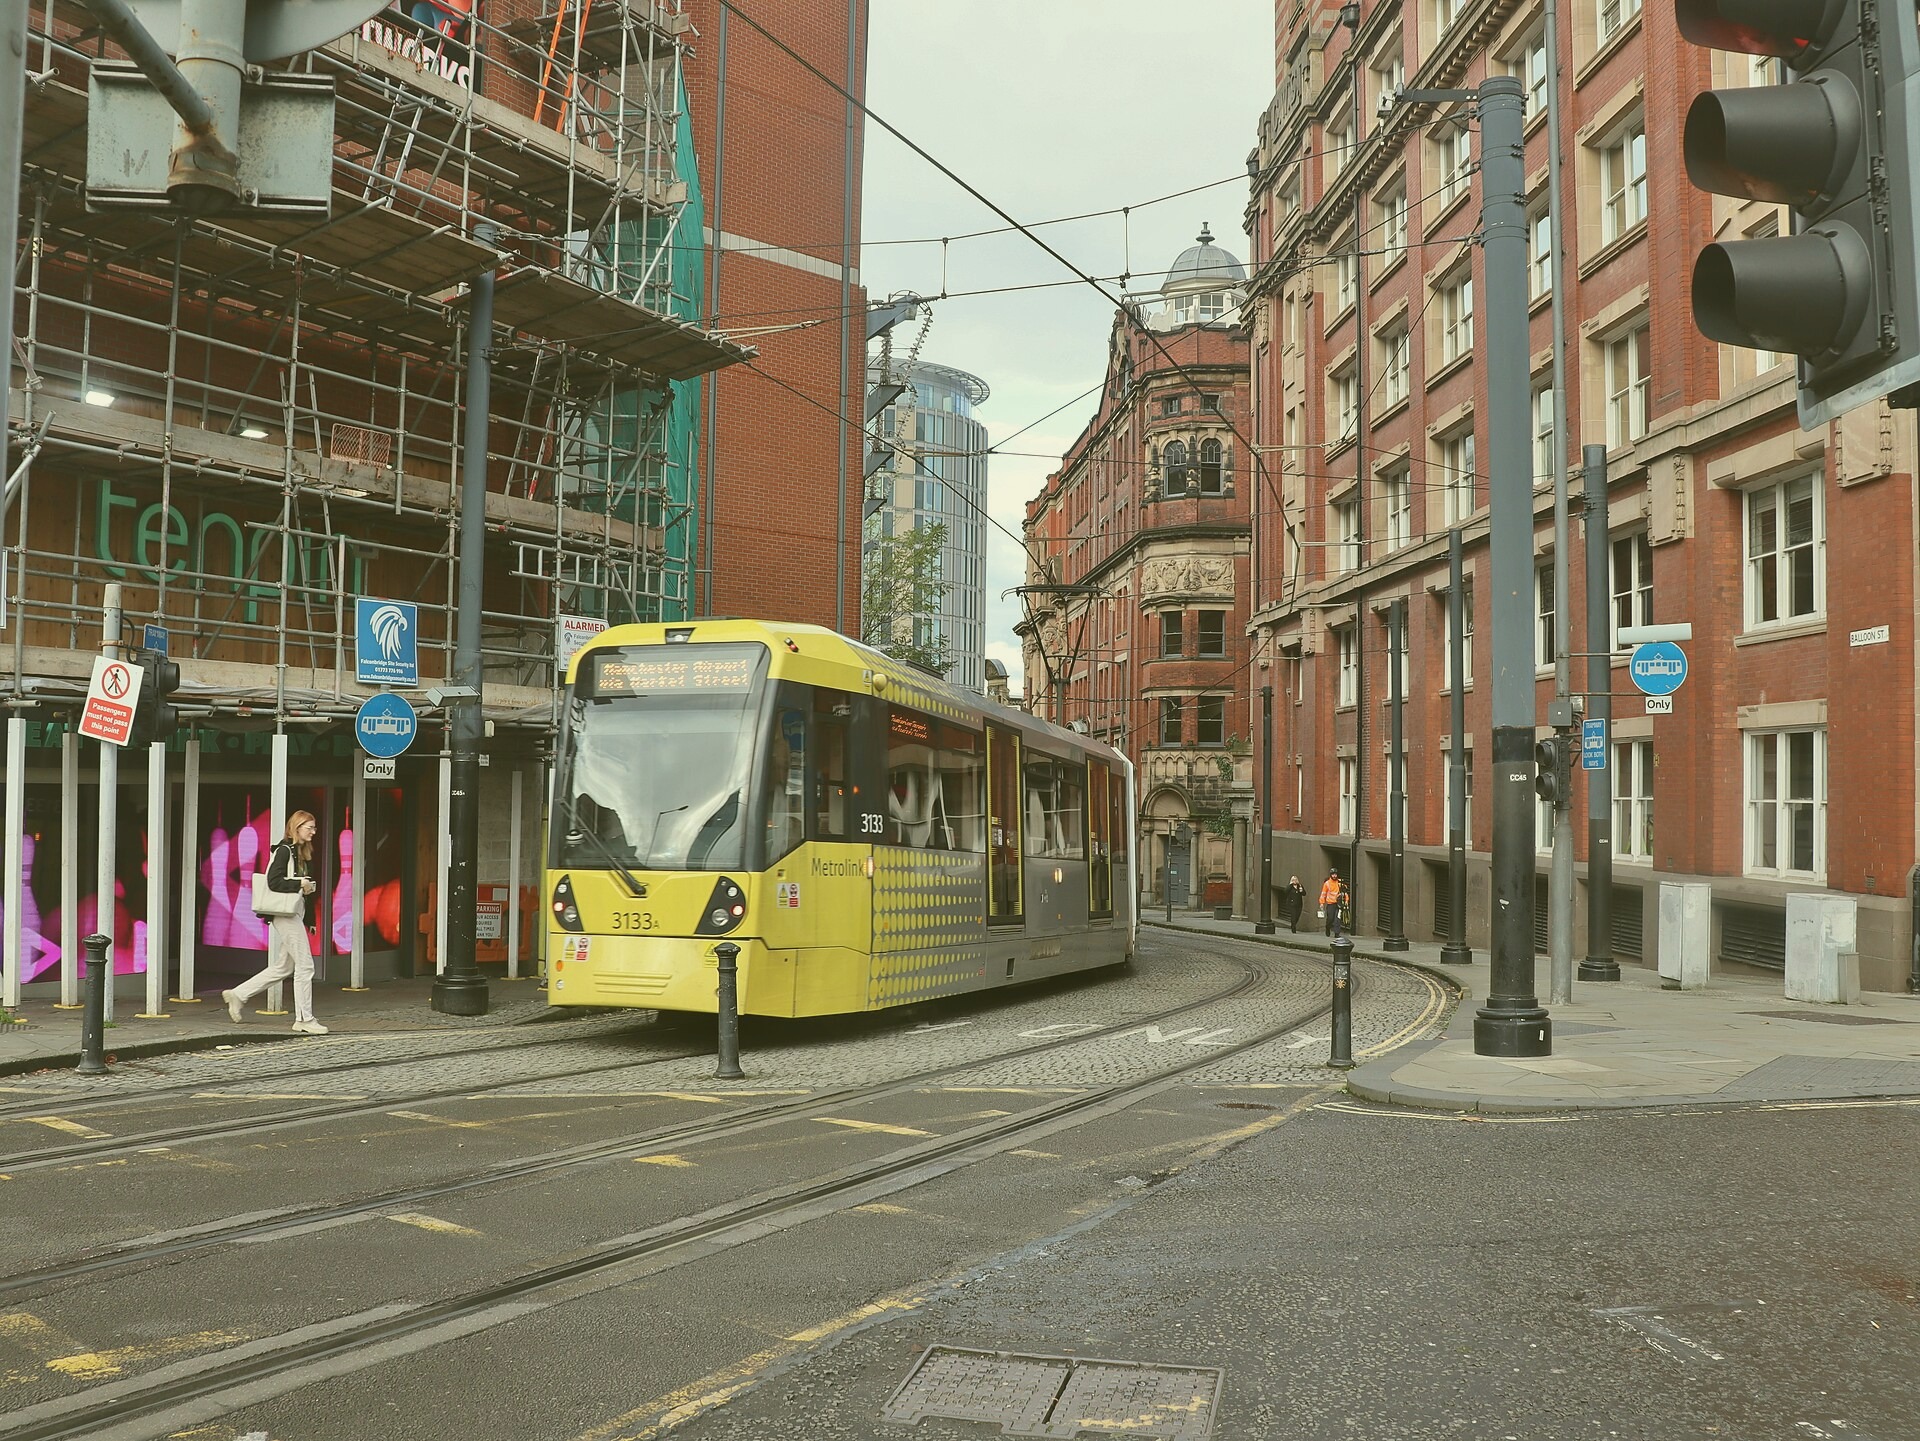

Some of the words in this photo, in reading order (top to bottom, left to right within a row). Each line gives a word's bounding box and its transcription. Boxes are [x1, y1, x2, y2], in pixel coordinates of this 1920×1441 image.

[97, 480, 363, 623] tenpin
[564, 620, 606, 633] ALARMED
[1851, 631, 1876, 644] BALLOON
[1877, 629, 1885, 640] ST
[395, 661, 409, 669] Security
[693, 659, 747, 673] Airport
[599, 678, 625, 689] via
[629, 675, 685, 688] Market
[693, 673, 748, 687] Street
[92, 701, 128, 718] Passengers
[1646, 699, 1671, 711] Only
[86, 711, 102, 721] must
[102, 715, 114, 724] not
[113, 719, 128, 727] pass
[91, 721, 103, 730] this
[103, 725, 120, 735] point
[365, 762, 394, 776] Only
[1510, 774, 1527, 782] CC45
[860, 813, 884, 834] 3133
[811, 858, 865, 876] Metrolink
[476, 905, 500, 913] PARKING
